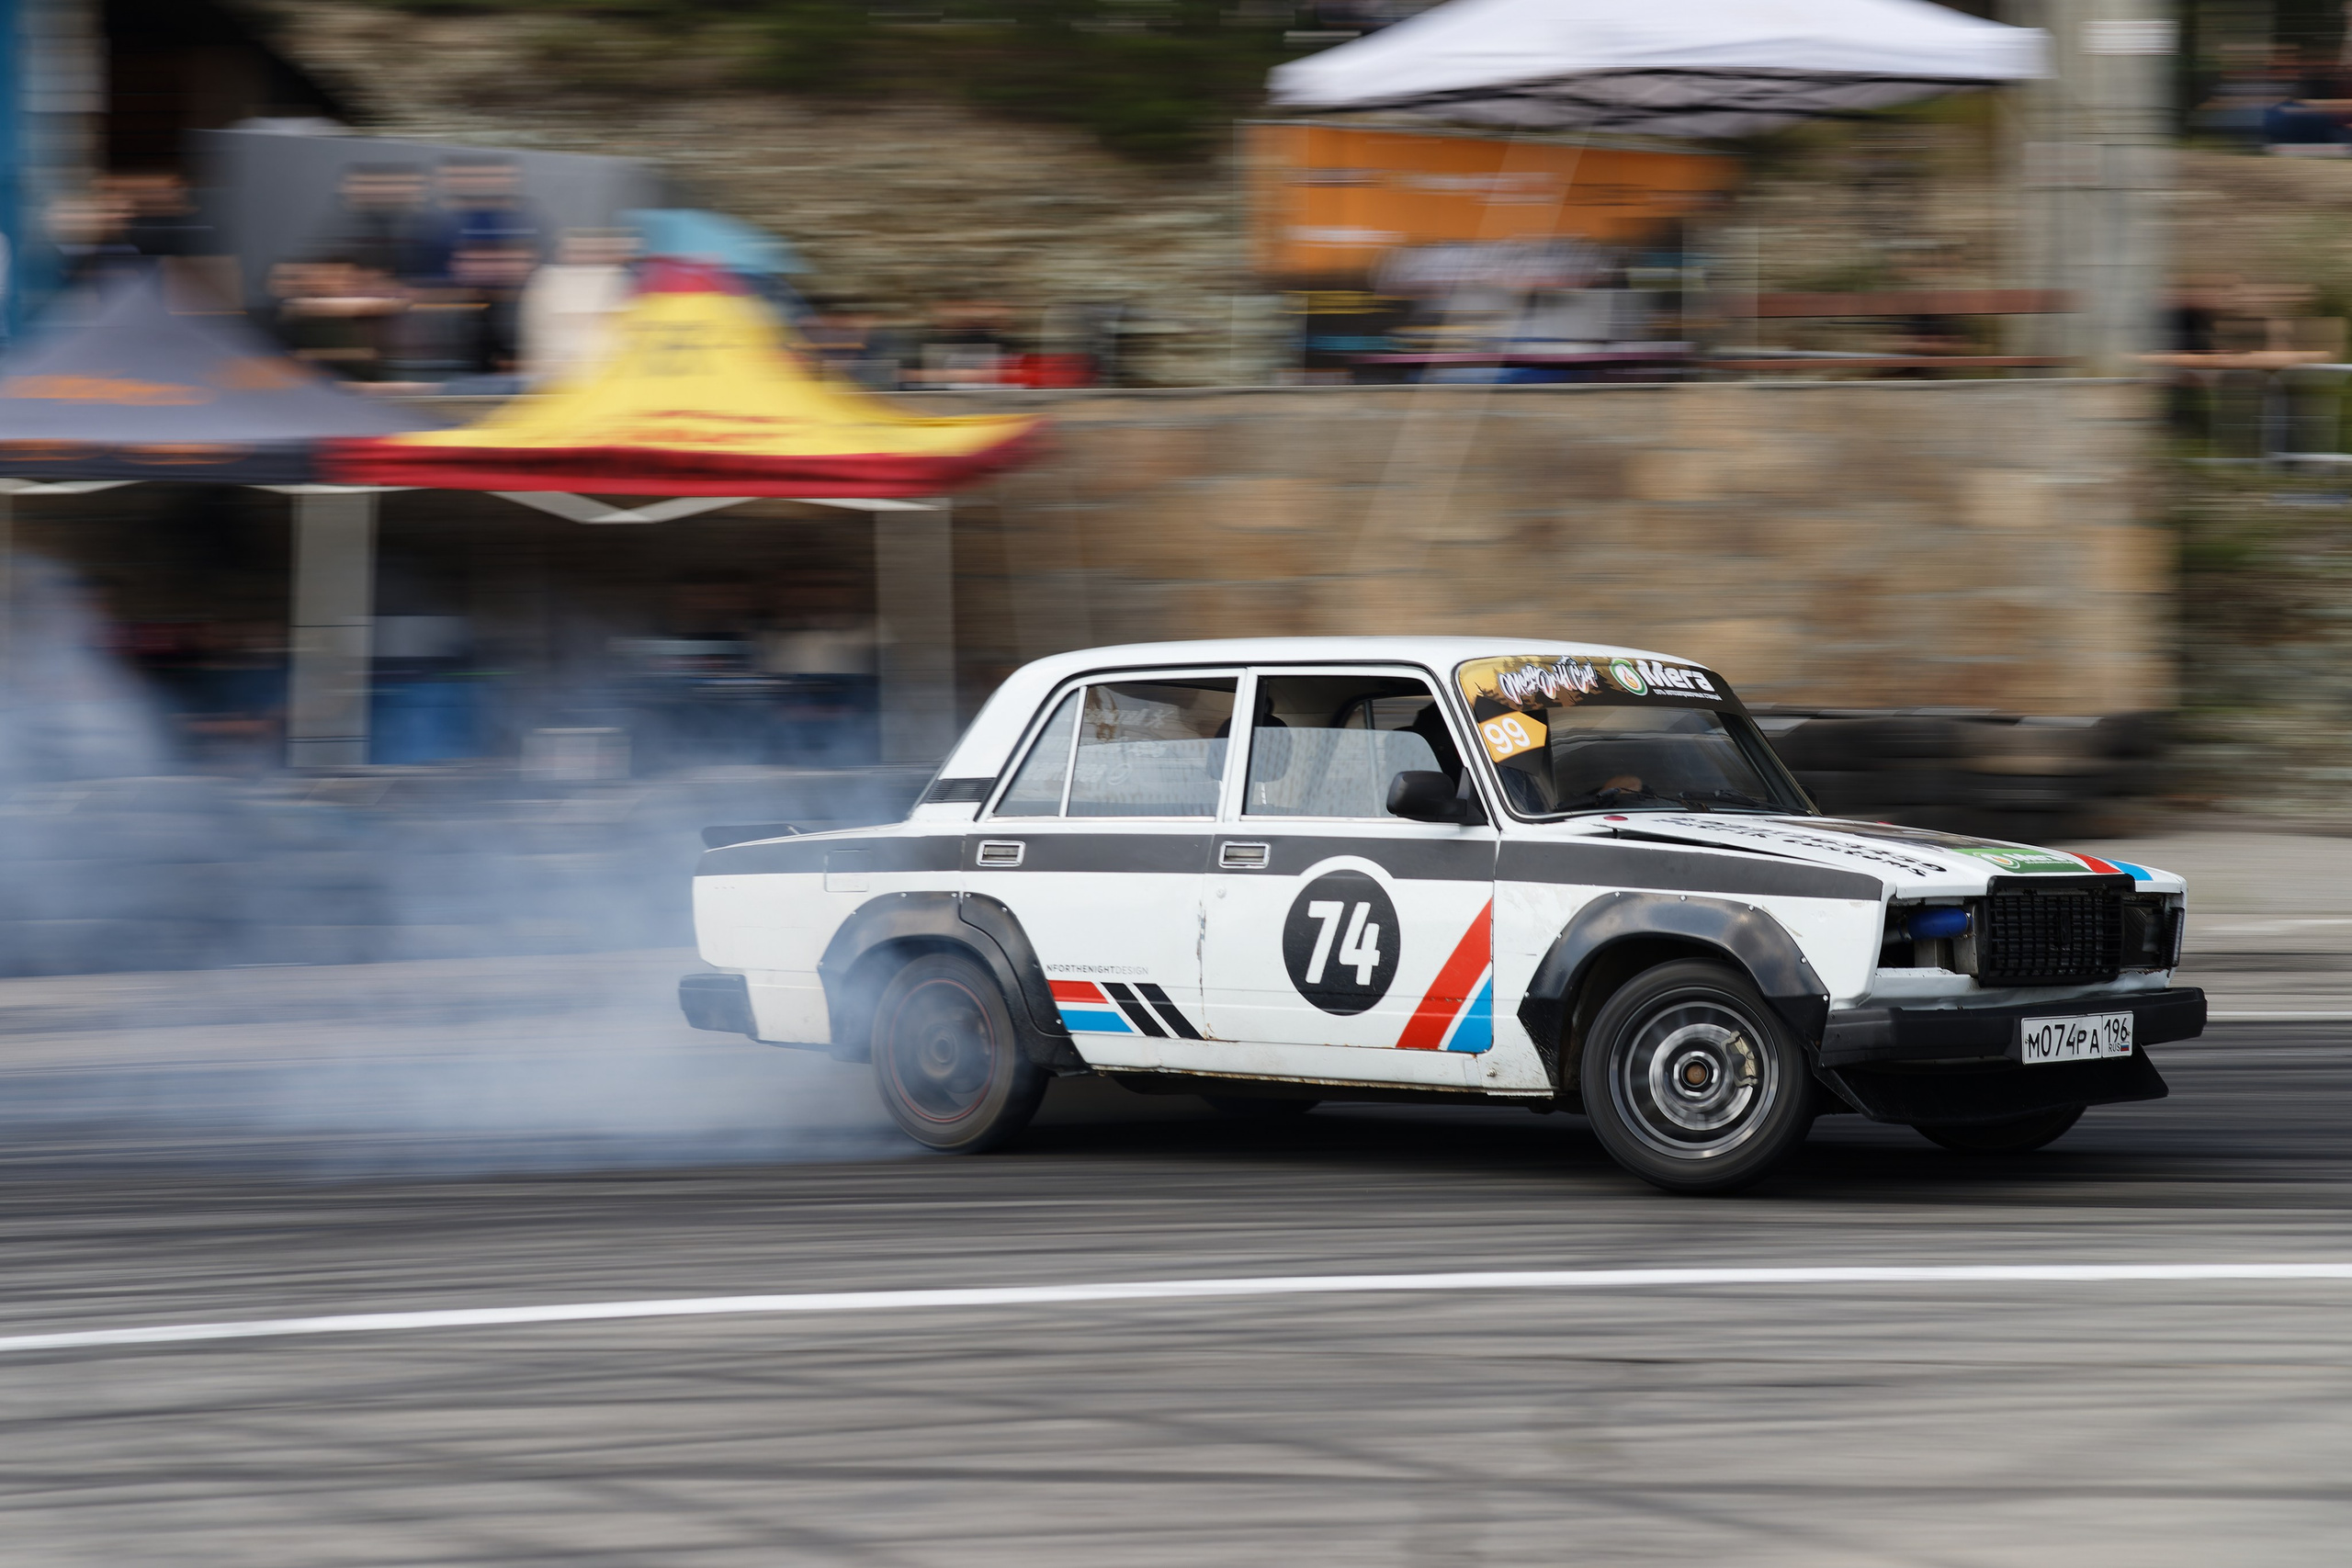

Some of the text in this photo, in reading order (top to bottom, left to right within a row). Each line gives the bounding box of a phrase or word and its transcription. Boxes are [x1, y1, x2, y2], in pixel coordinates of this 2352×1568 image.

[1483, 716, 1532, 754] 99
[1306, 900, 1381, 987] 74
[2103, 1017, 2128, 1043] 196
[2108, 1043, 2121, 1053] RUS
